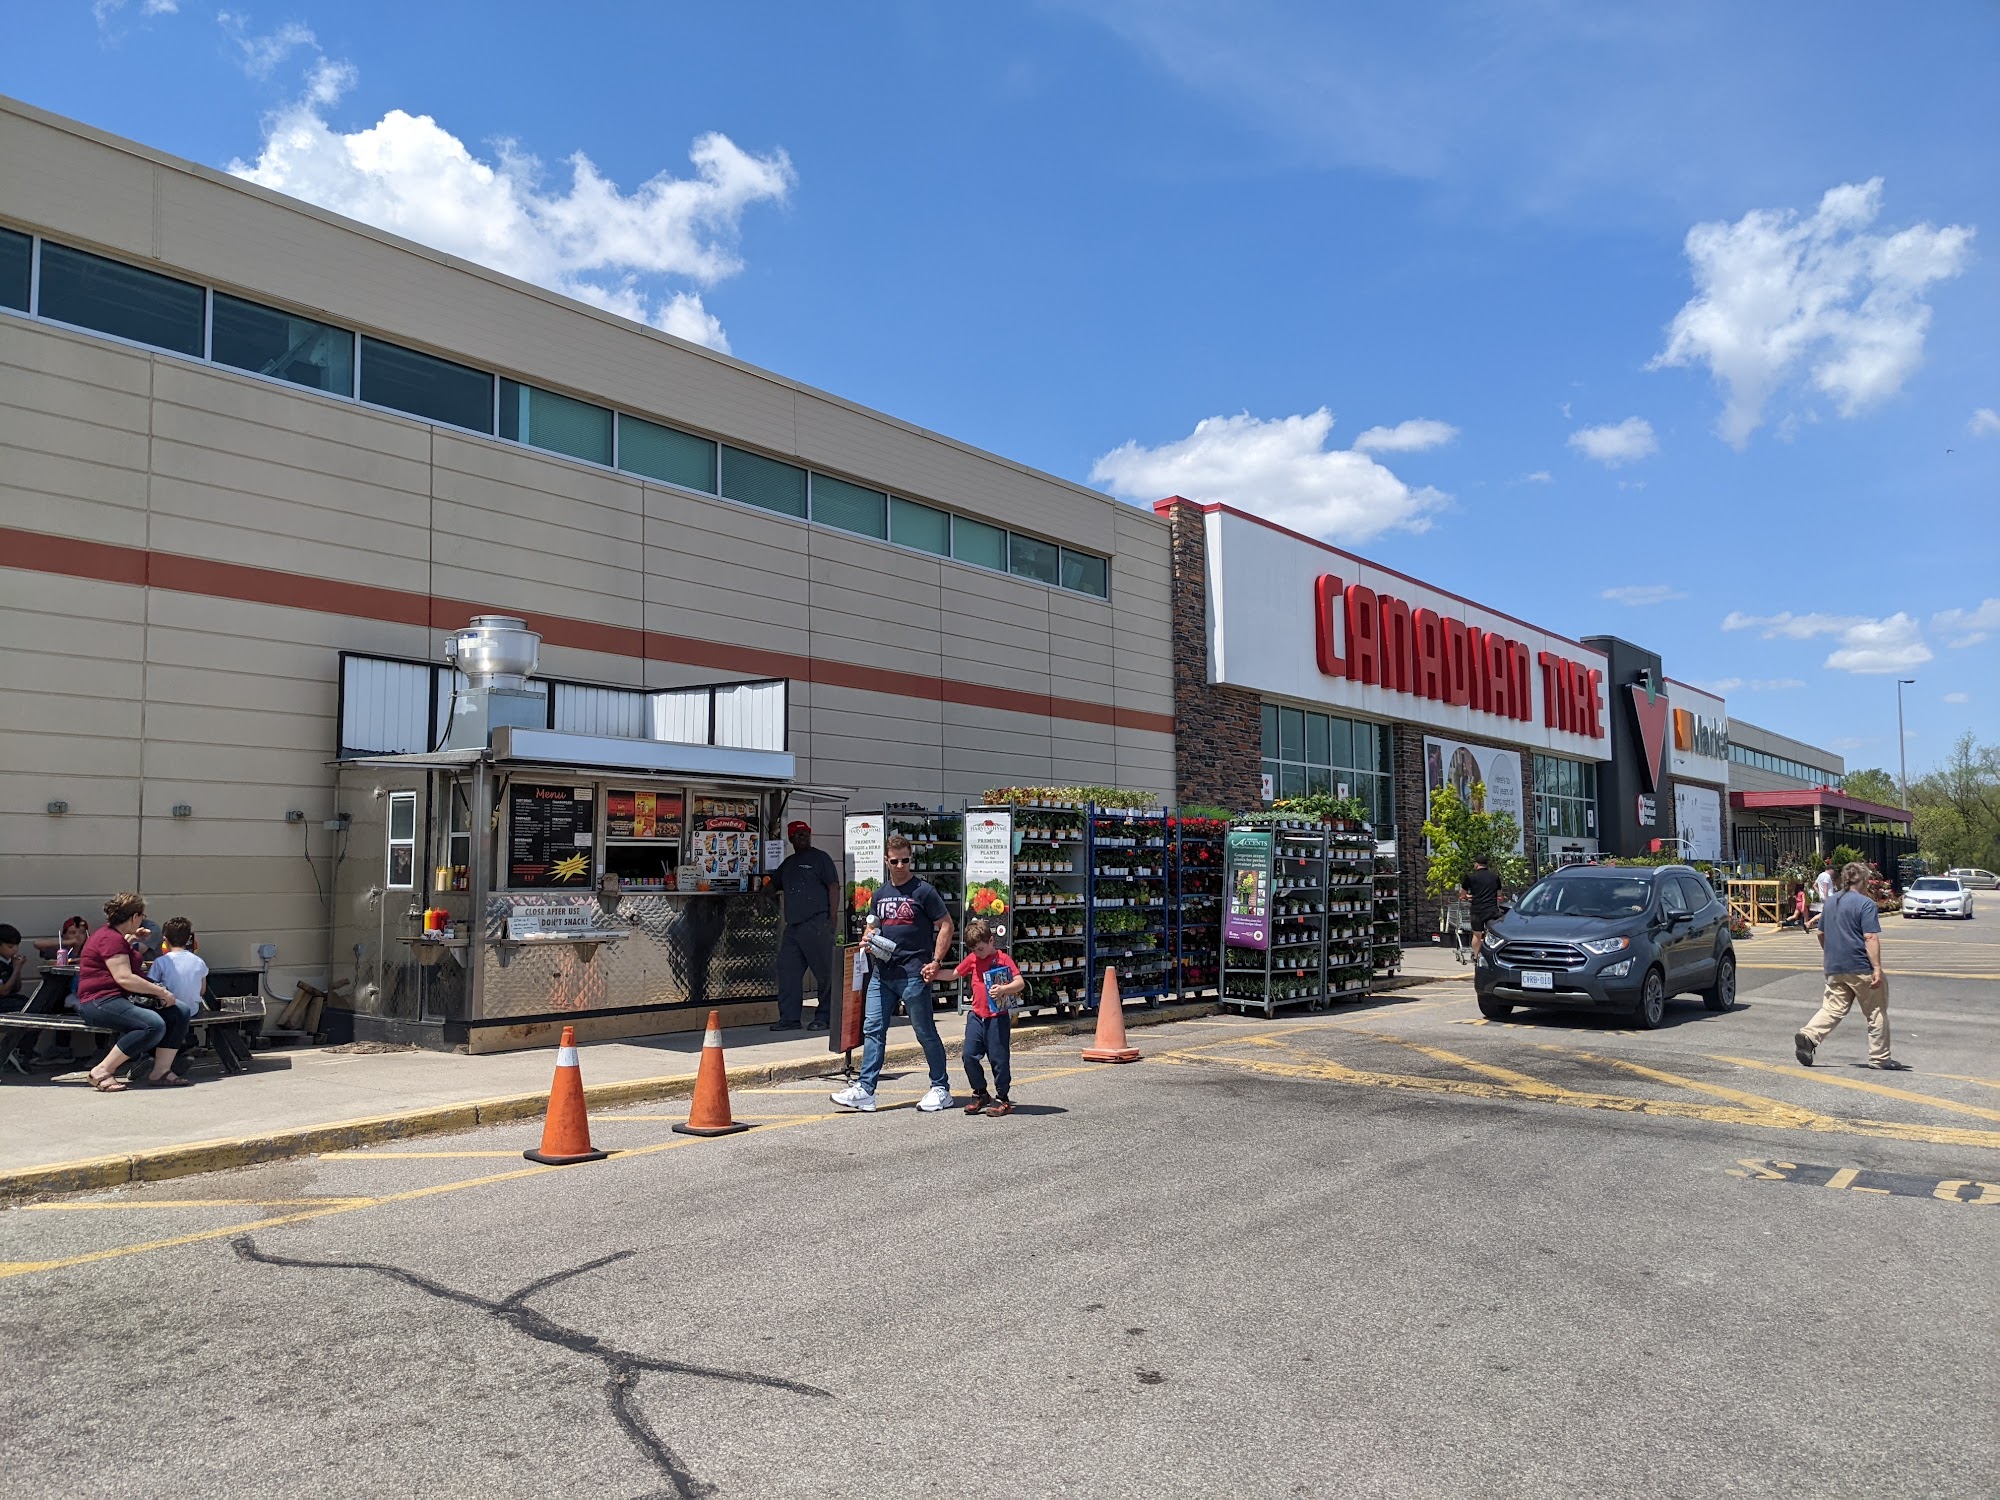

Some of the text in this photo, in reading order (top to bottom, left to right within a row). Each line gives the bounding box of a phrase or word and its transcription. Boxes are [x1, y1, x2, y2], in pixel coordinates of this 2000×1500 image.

[1315, 574, 1605, 739] CANADIAN TIRE
[1693, 714, 1729, 761] Mark's
[536, 788, 567, 799] Menu
[710, 820, 742, 828] Combos
[1231, 838, 1268, 846] ACCENTS
